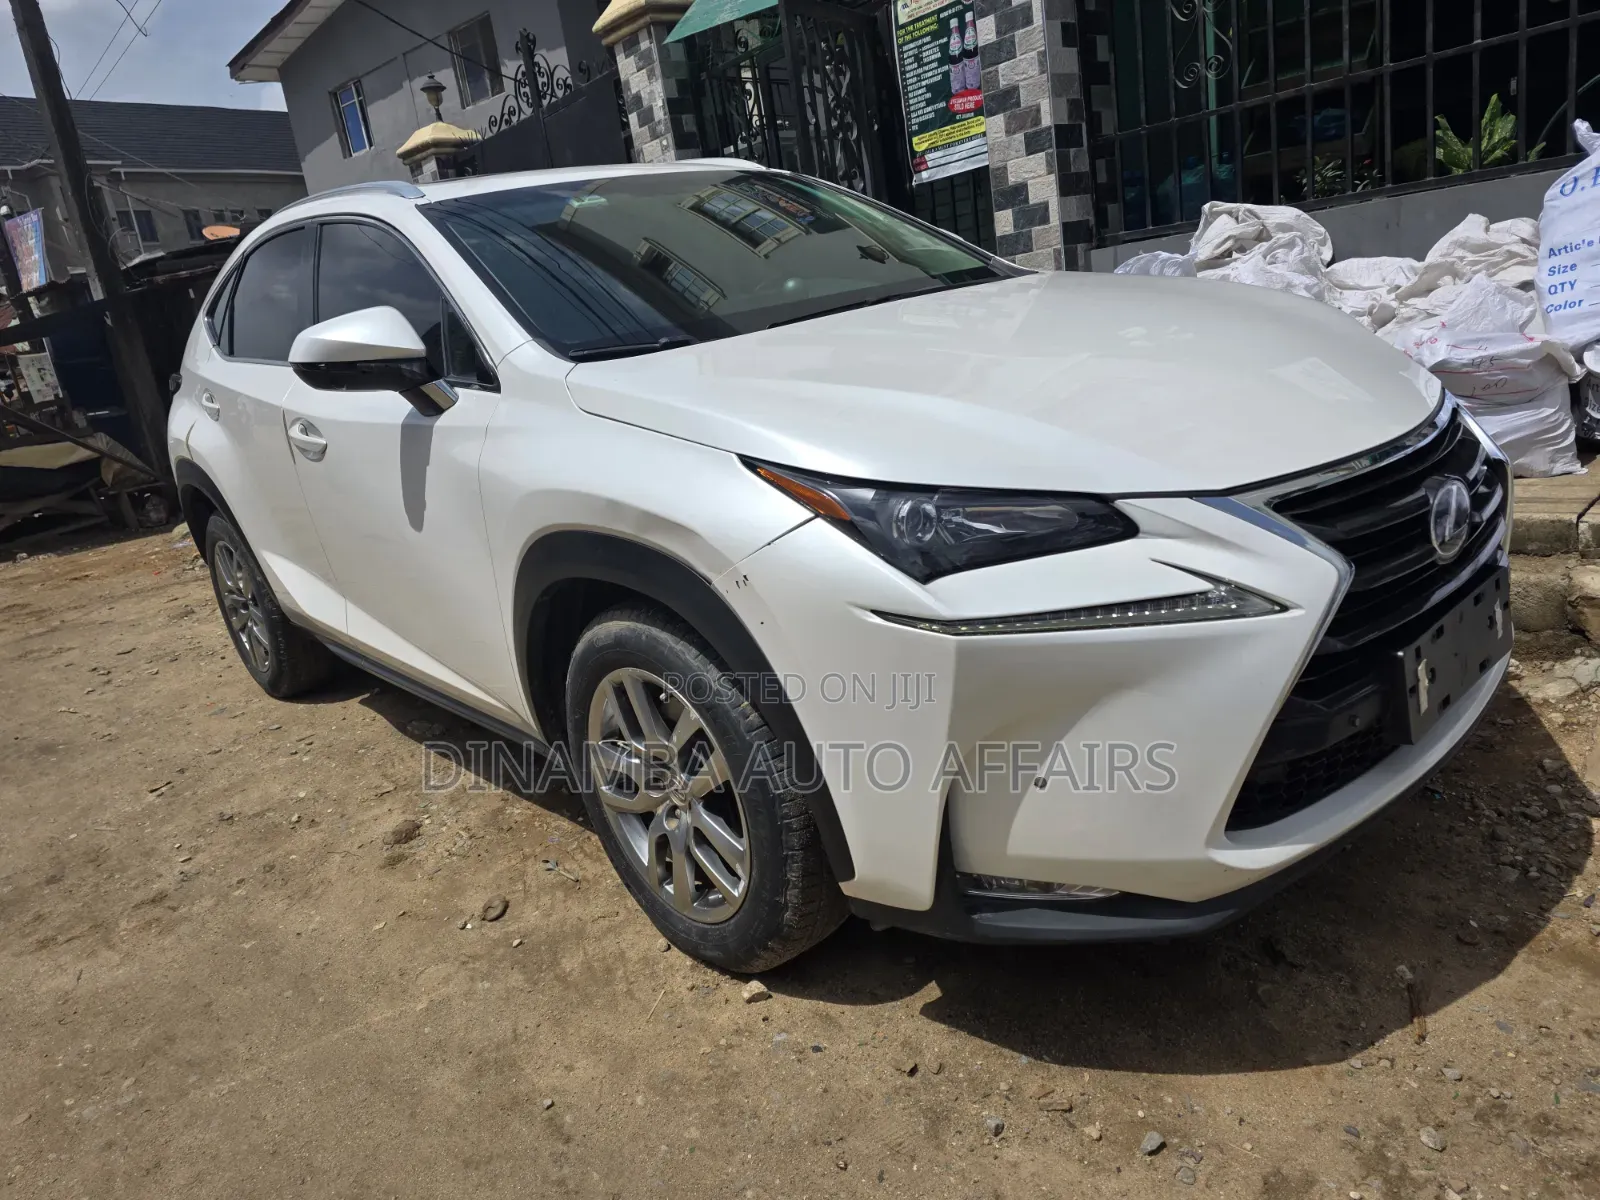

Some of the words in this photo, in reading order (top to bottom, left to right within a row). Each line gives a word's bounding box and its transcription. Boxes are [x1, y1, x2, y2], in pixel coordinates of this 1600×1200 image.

[1547, 262, 1578, 277] Size
[1547, 279, 1577, 296] QTY
[1545, 299, 1585, 314] Color
